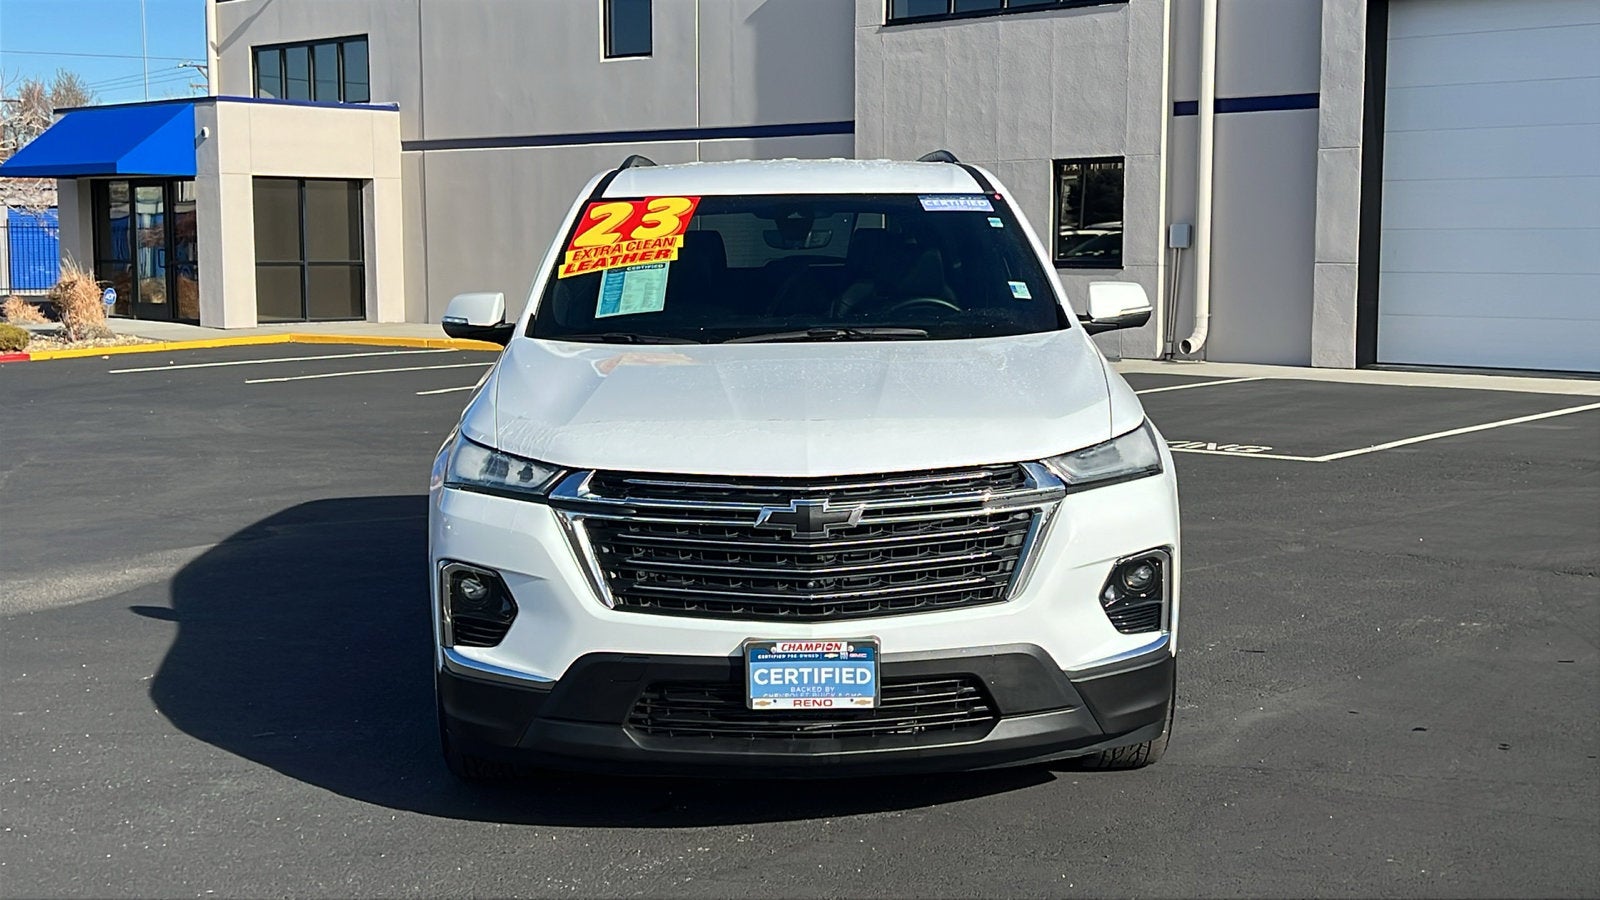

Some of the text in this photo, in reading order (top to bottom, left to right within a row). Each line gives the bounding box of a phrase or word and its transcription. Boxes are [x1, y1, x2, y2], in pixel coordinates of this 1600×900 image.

[924, 199, 988, 207] CERTIFIED
[574, 197, 694, 247] 23
[573, 237, 677, 261] EXTRA CLEAN
[563, 249, 674, 275] LEATHER
[626, 263, 664, 272] CERTIFIED
[780, 643, 842, 652] CHAMPION
[753, 667, 872, 685] CERTIFIED
[793, 699, 833, 707] RENO
